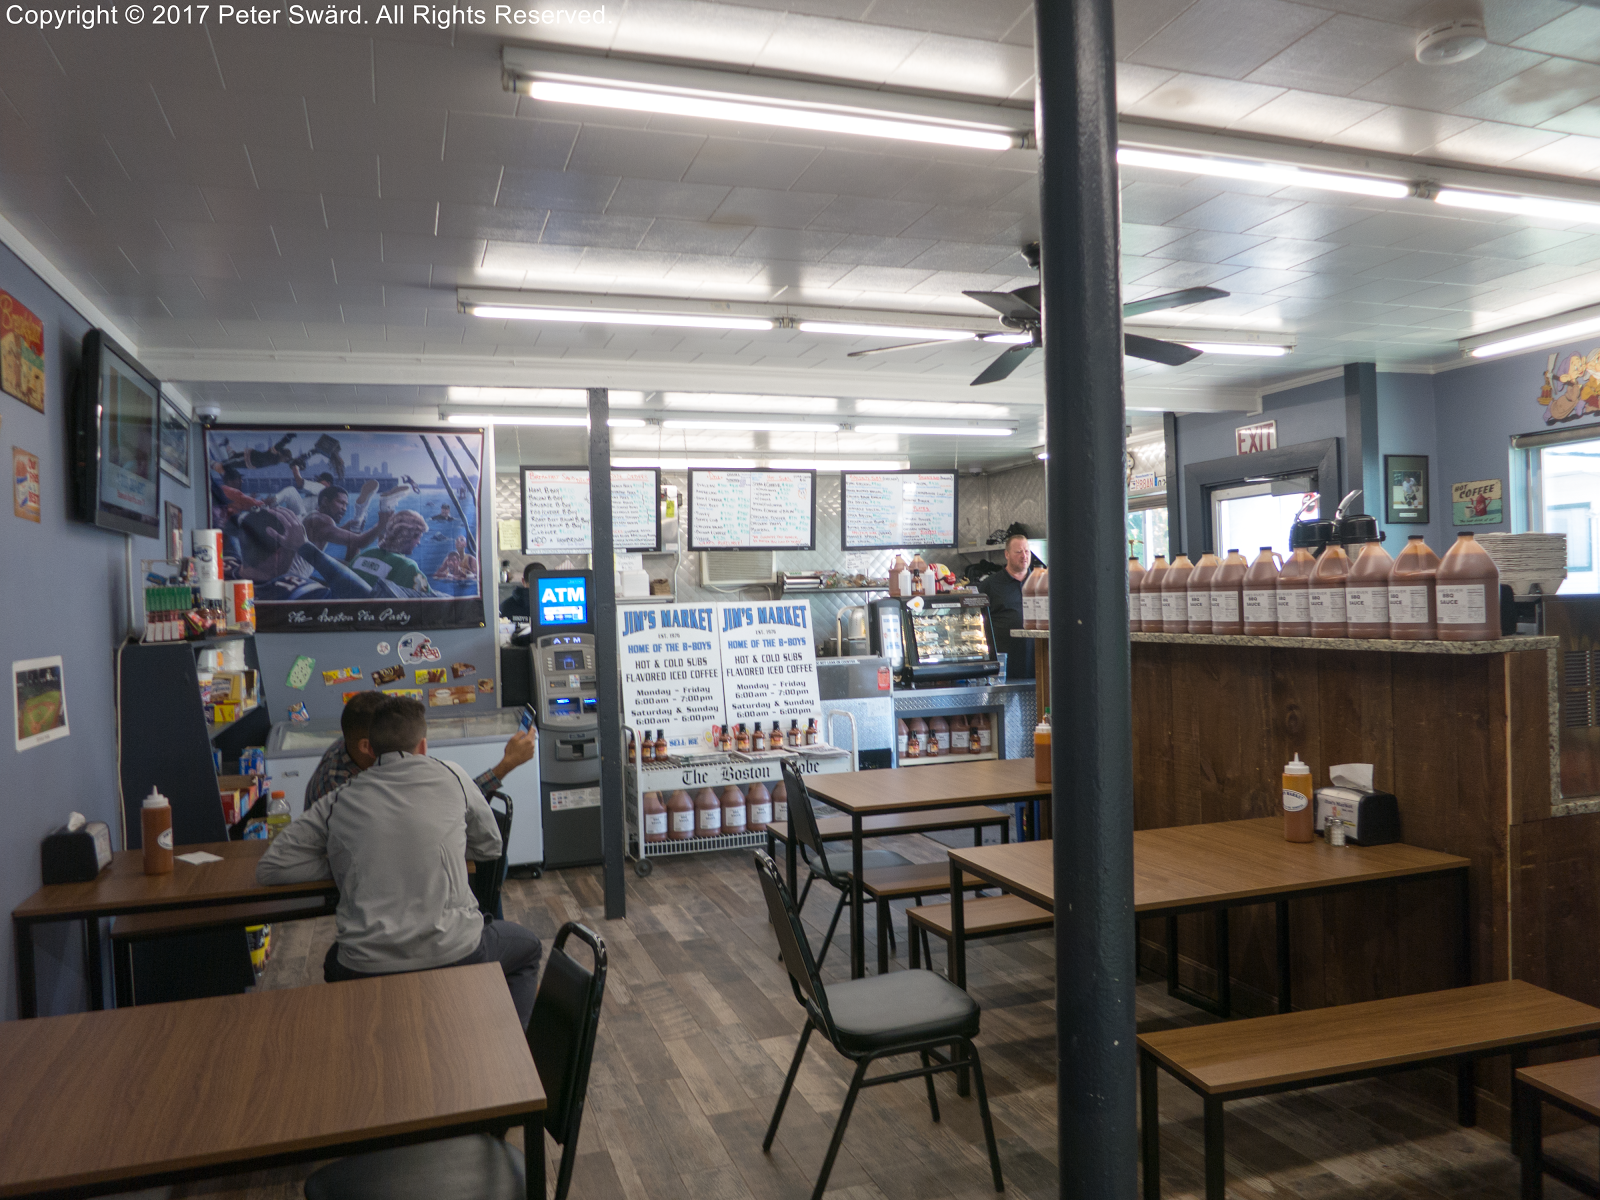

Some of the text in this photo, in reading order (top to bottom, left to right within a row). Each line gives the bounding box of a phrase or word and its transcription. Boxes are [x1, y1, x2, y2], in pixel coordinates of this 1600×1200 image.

[1238, 422, 1274, 455] EXIT
[1454, 484, 1468, 492] HOT
[1460, 484, 1495, 498] COFFEE
[362, 559, 380, 572] BIRD
[542, 587, 584, 603] ATM
[317, 608, 354, 623] Boston
[378, 608, 411, 625] Party
[623, 608, 712, 637] JIM'S MARKET
[723, 605, 806, 632] JIM'S MARKET
[553, 636, 582, 644] ATM
[728, 637, 806, 649] HOME OF THE B-BOYS
[628, 641, 711, 654] HOME OF THE B-BOYS
[635, 657, 707, 670] HOT & COLD SUBS
[735, 652, 802, 664] HOT & COLD SUBS
[626, 669, 718, 682] FLAVORED ICED COFFEE
[726, 664, 813, 677] FLAVORED ICED COFFEE
[681, 695, 713, 703] 7:00pm
[778, 689, 809, 697] 7:00pm
[631, 708, 672, 717] Saturday
[732, 702, 770, 710] Saturday
[682, 769, 708, 785] The
[721, 766, 770, 782] Boston
